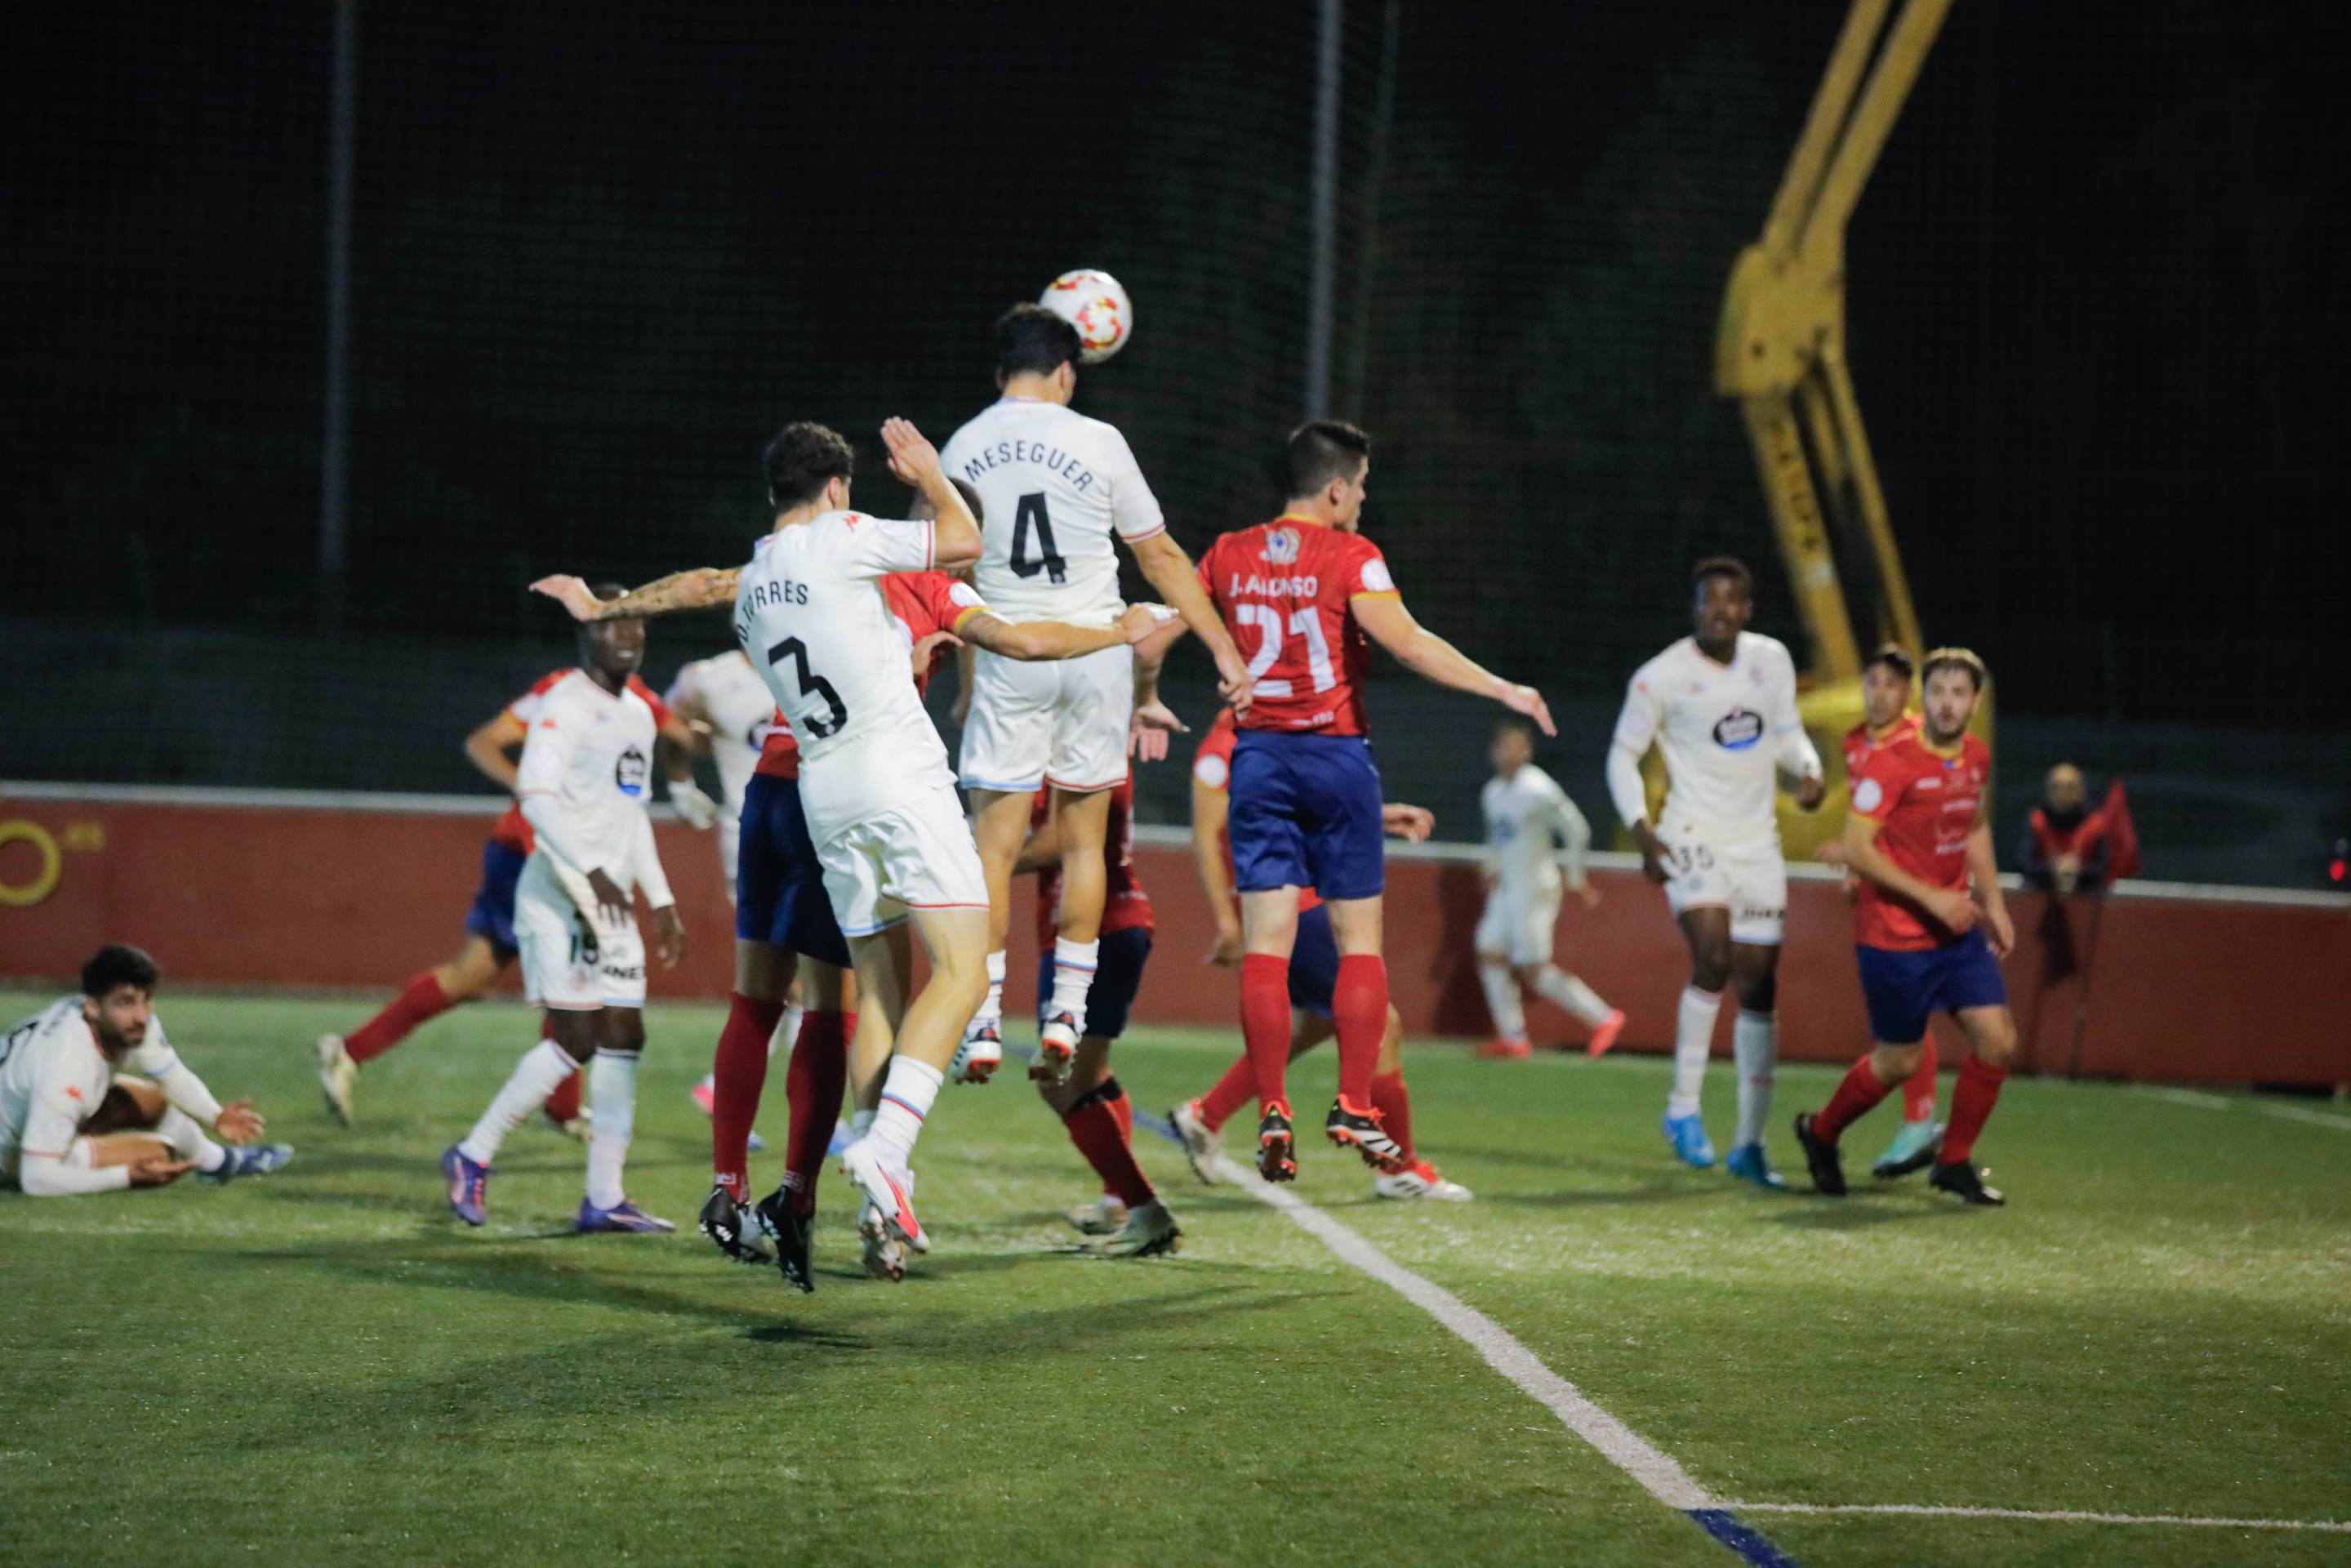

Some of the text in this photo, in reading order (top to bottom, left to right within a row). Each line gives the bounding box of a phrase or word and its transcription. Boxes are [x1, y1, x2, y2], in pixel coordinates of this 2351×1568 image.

[965, 440, 1093, 492] MESEGUER
[1010, 491, 1066, 584] 4
[768, 635, 847, 738] 3
[1236, 604, 1336, 697] 21
[1679, 844, 1714, 874] 35
